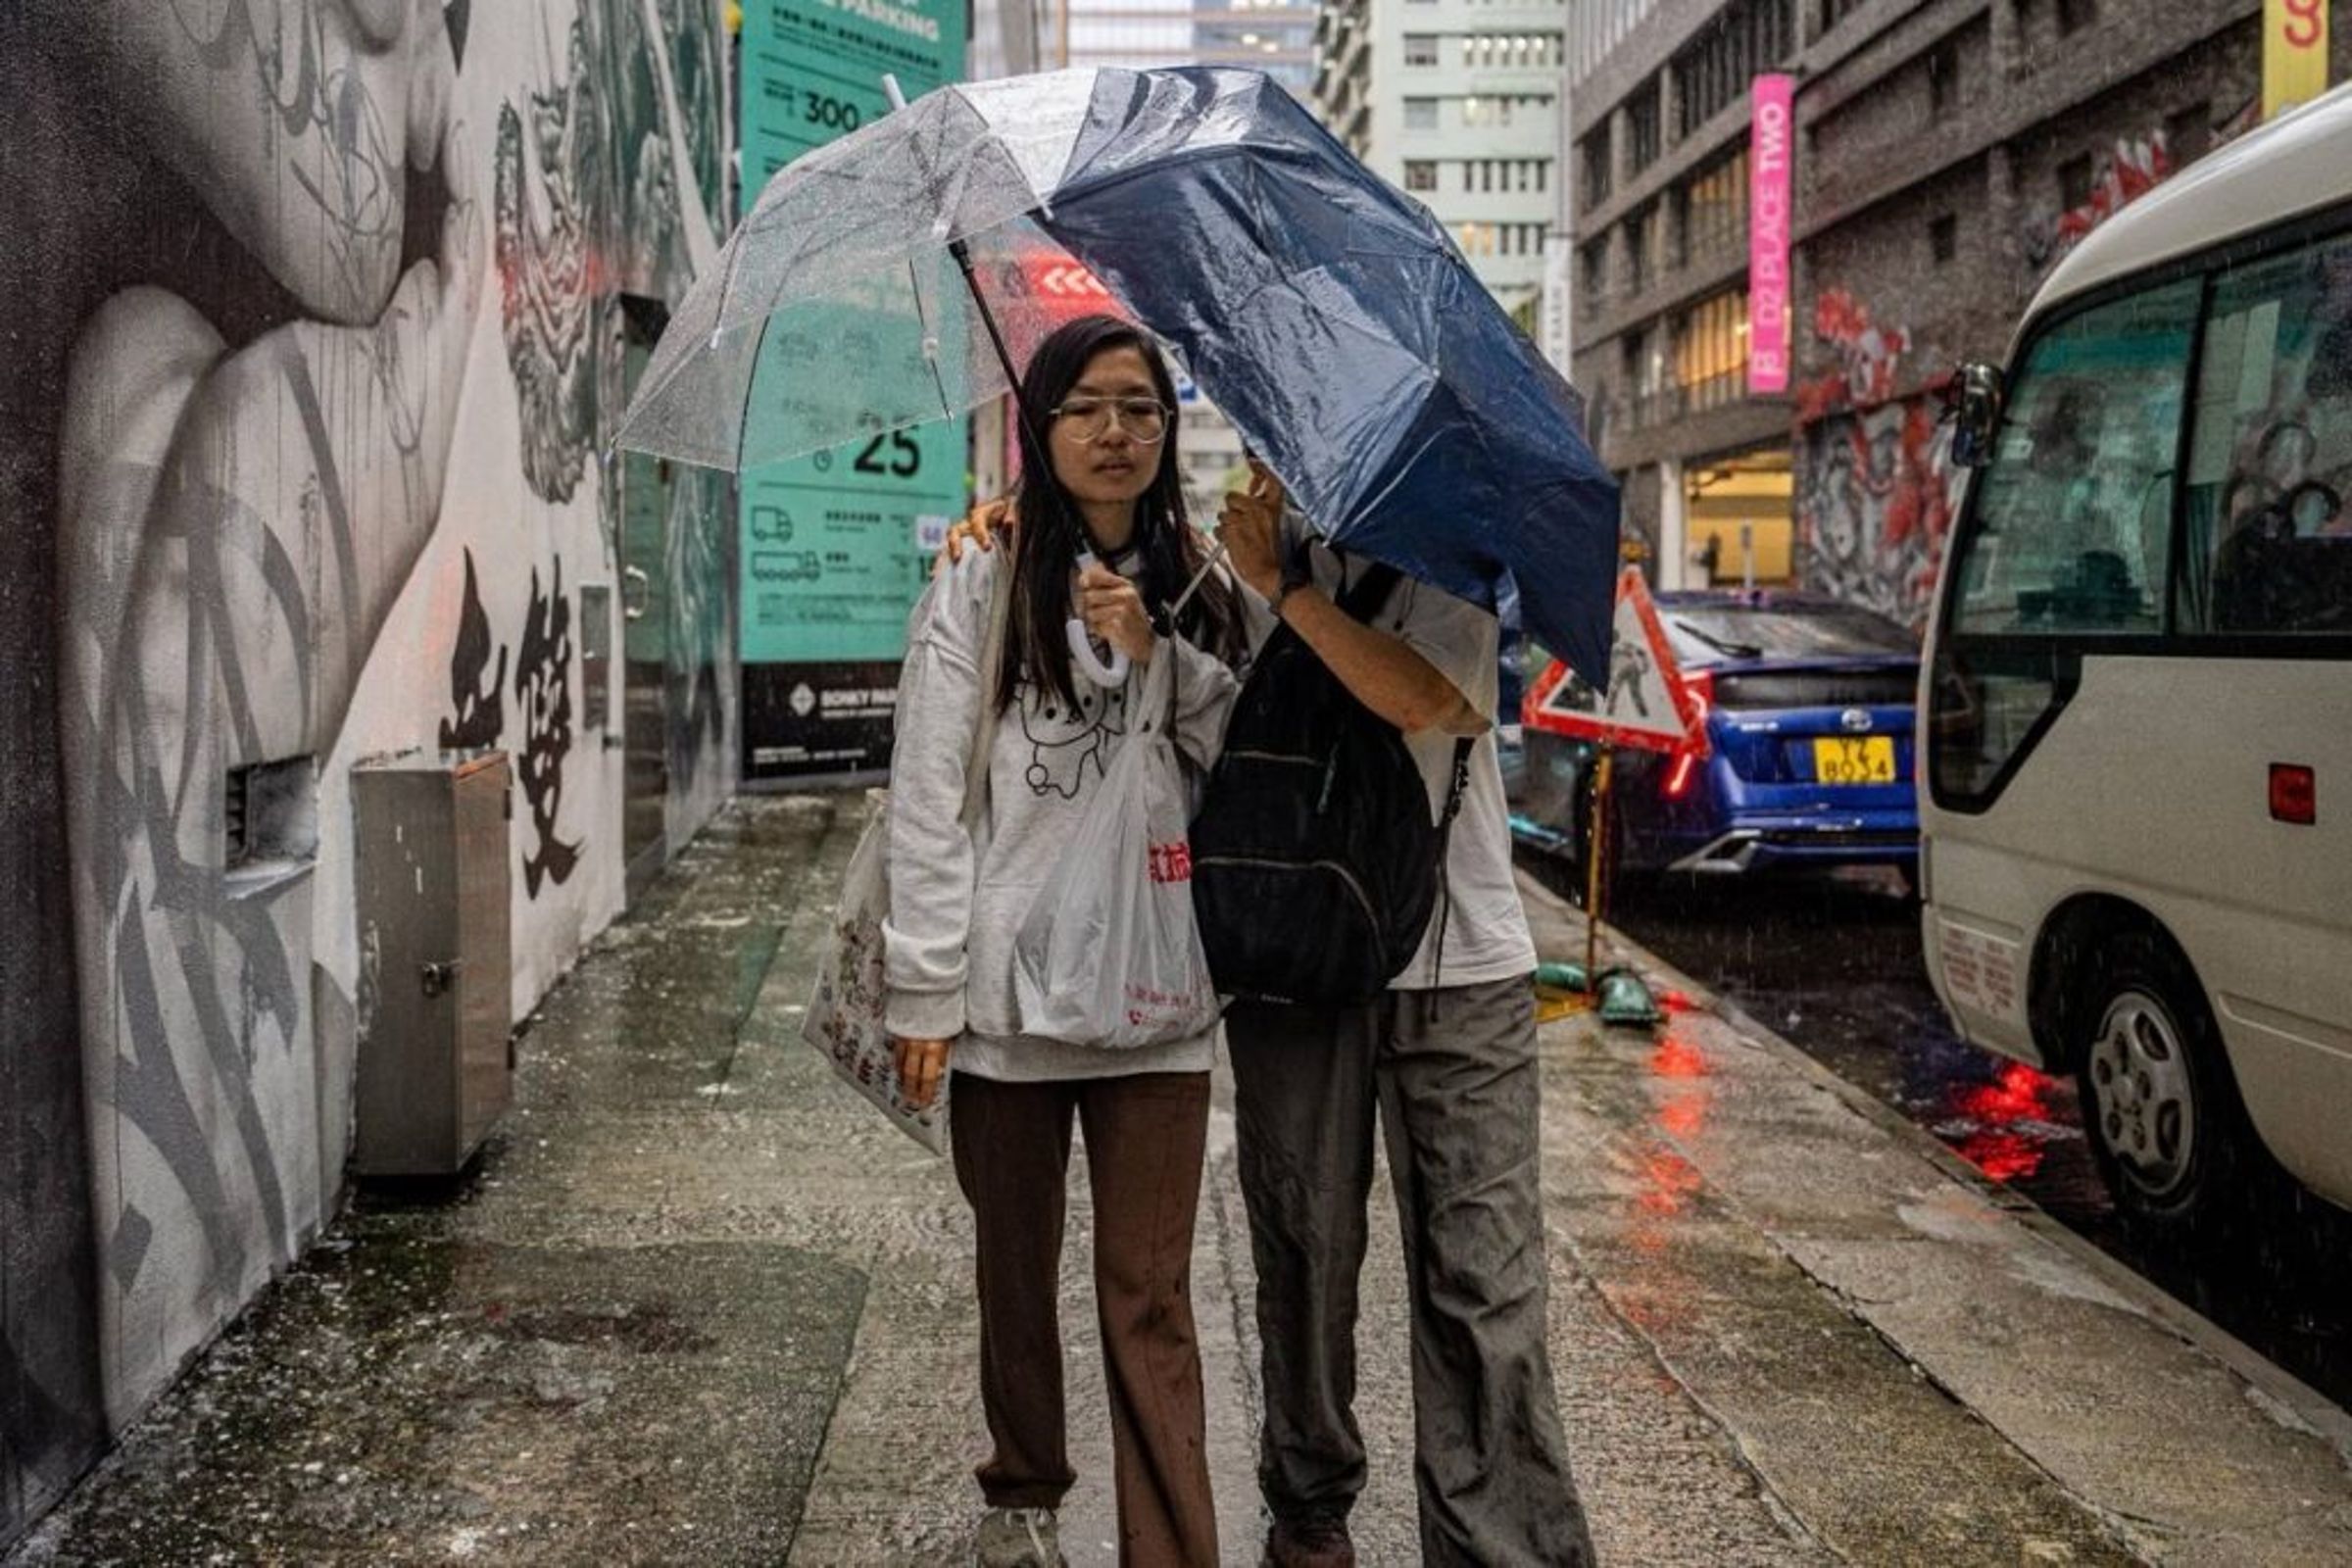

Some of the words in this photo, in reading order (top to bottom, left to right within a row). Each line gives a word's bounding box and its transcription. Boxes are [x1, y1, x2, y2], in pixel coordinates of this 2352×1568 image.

[804, 90, 859, 132] 300
[1758, 102, 1785, 173] TWO
[1758, 182, 1784, 281] PLACE
[1758, 289, 1783, 328] D2
[854, 410, 921, 478] 25
